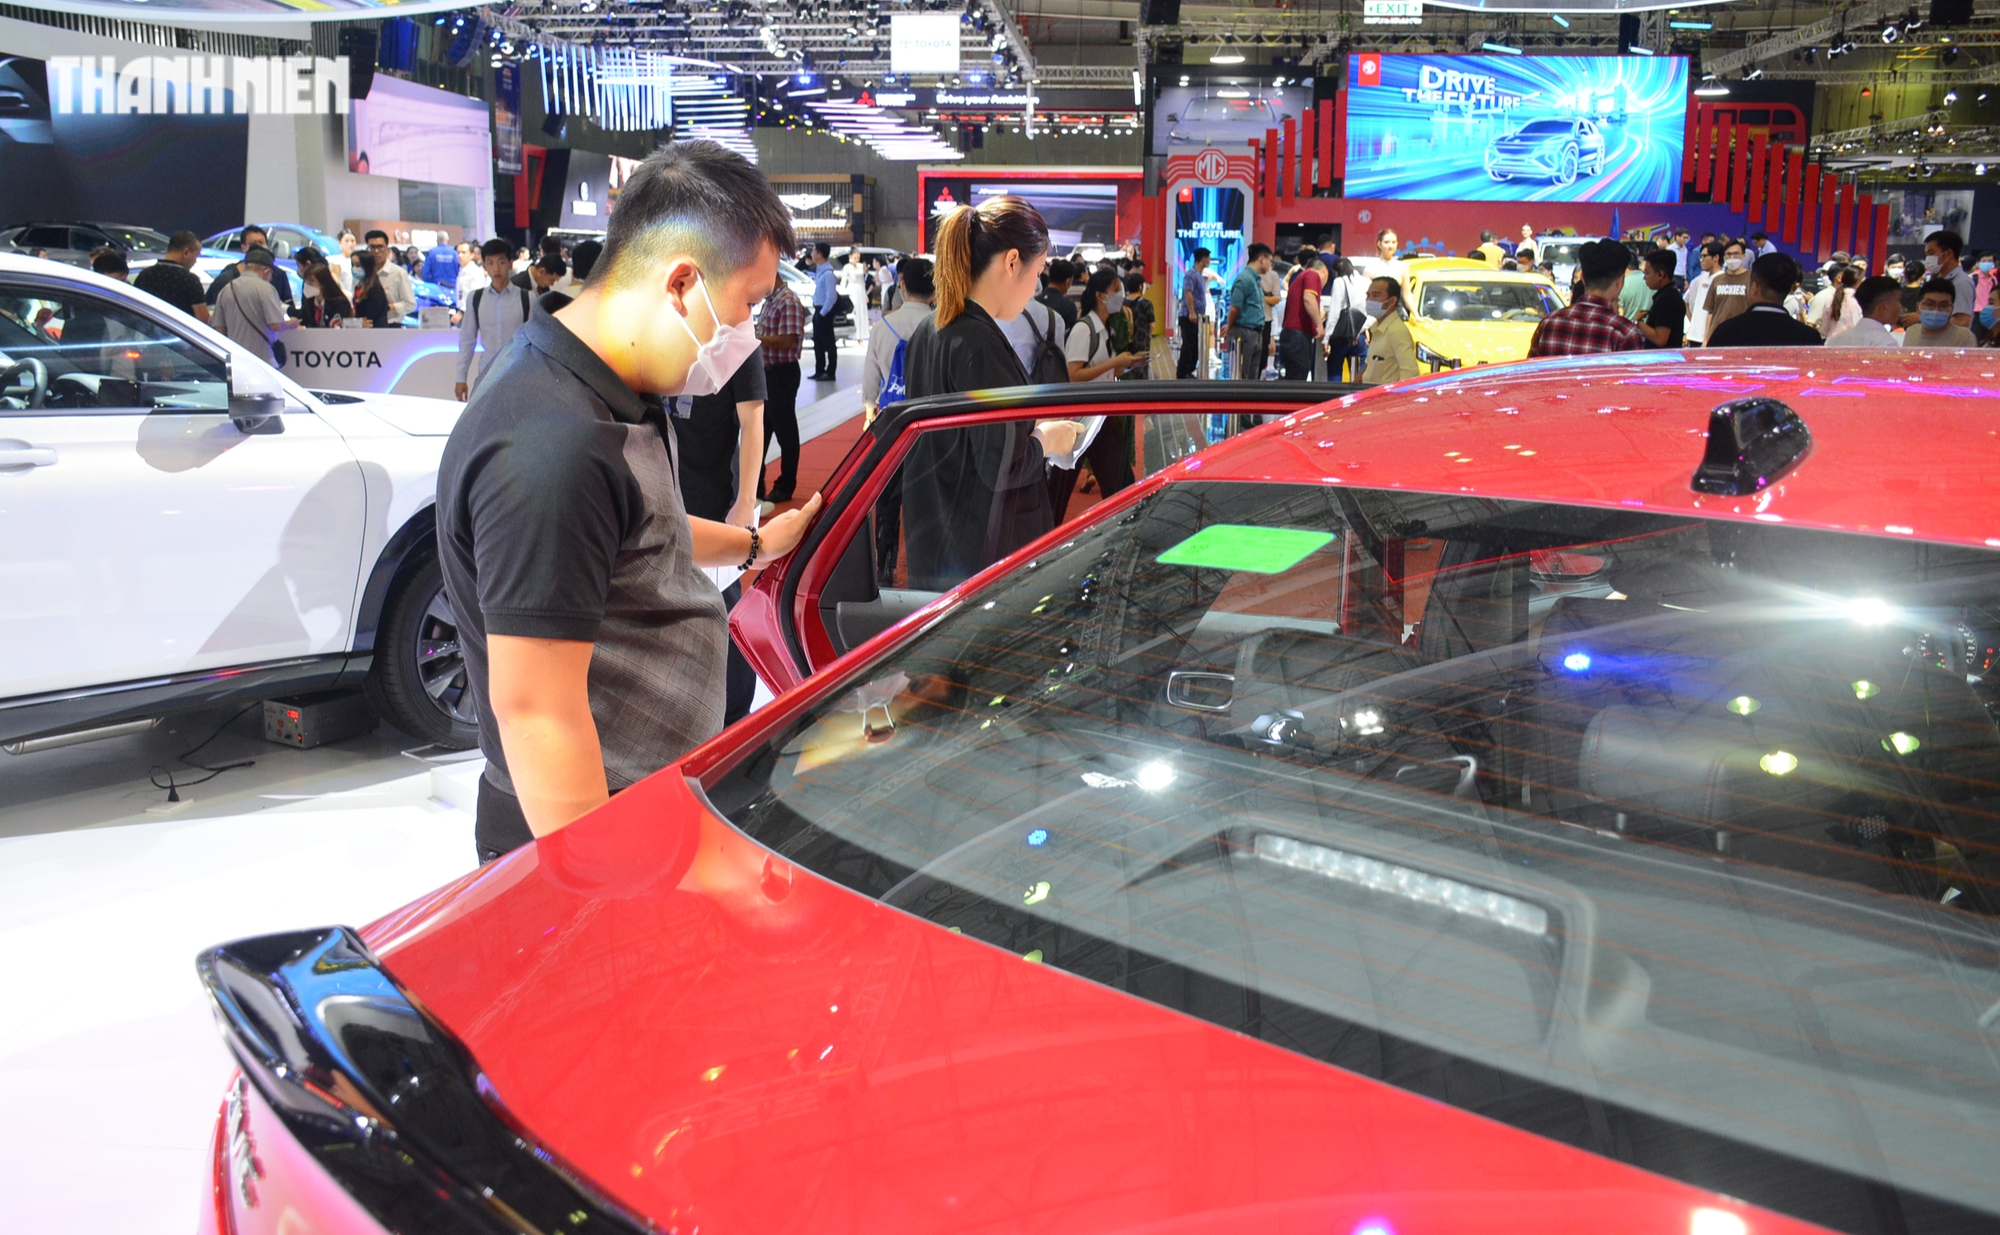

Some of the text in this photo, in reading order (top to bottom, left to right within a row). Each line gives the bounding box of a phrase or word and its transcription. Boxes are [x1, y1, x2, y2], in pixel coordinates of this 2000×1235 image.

[1376, 3, 1410, 14] EXIT
[915, 40, 952, 48] TOYOTA
[1419, 65, 1496, 94] DRIVE
[990, 94, 1040, 104] Ambitin
[1401, 88, 1521, 112] THE FUTURE
[1198, 153, 1225, 181] MG
[1192, 221, 1223, 230] DRIVE
[1177, 229, 1242, 238] THE FUTURE
[1716, 284, 1746, 296] DICKIES
[290, 351, 382, 368] TOYOTA
